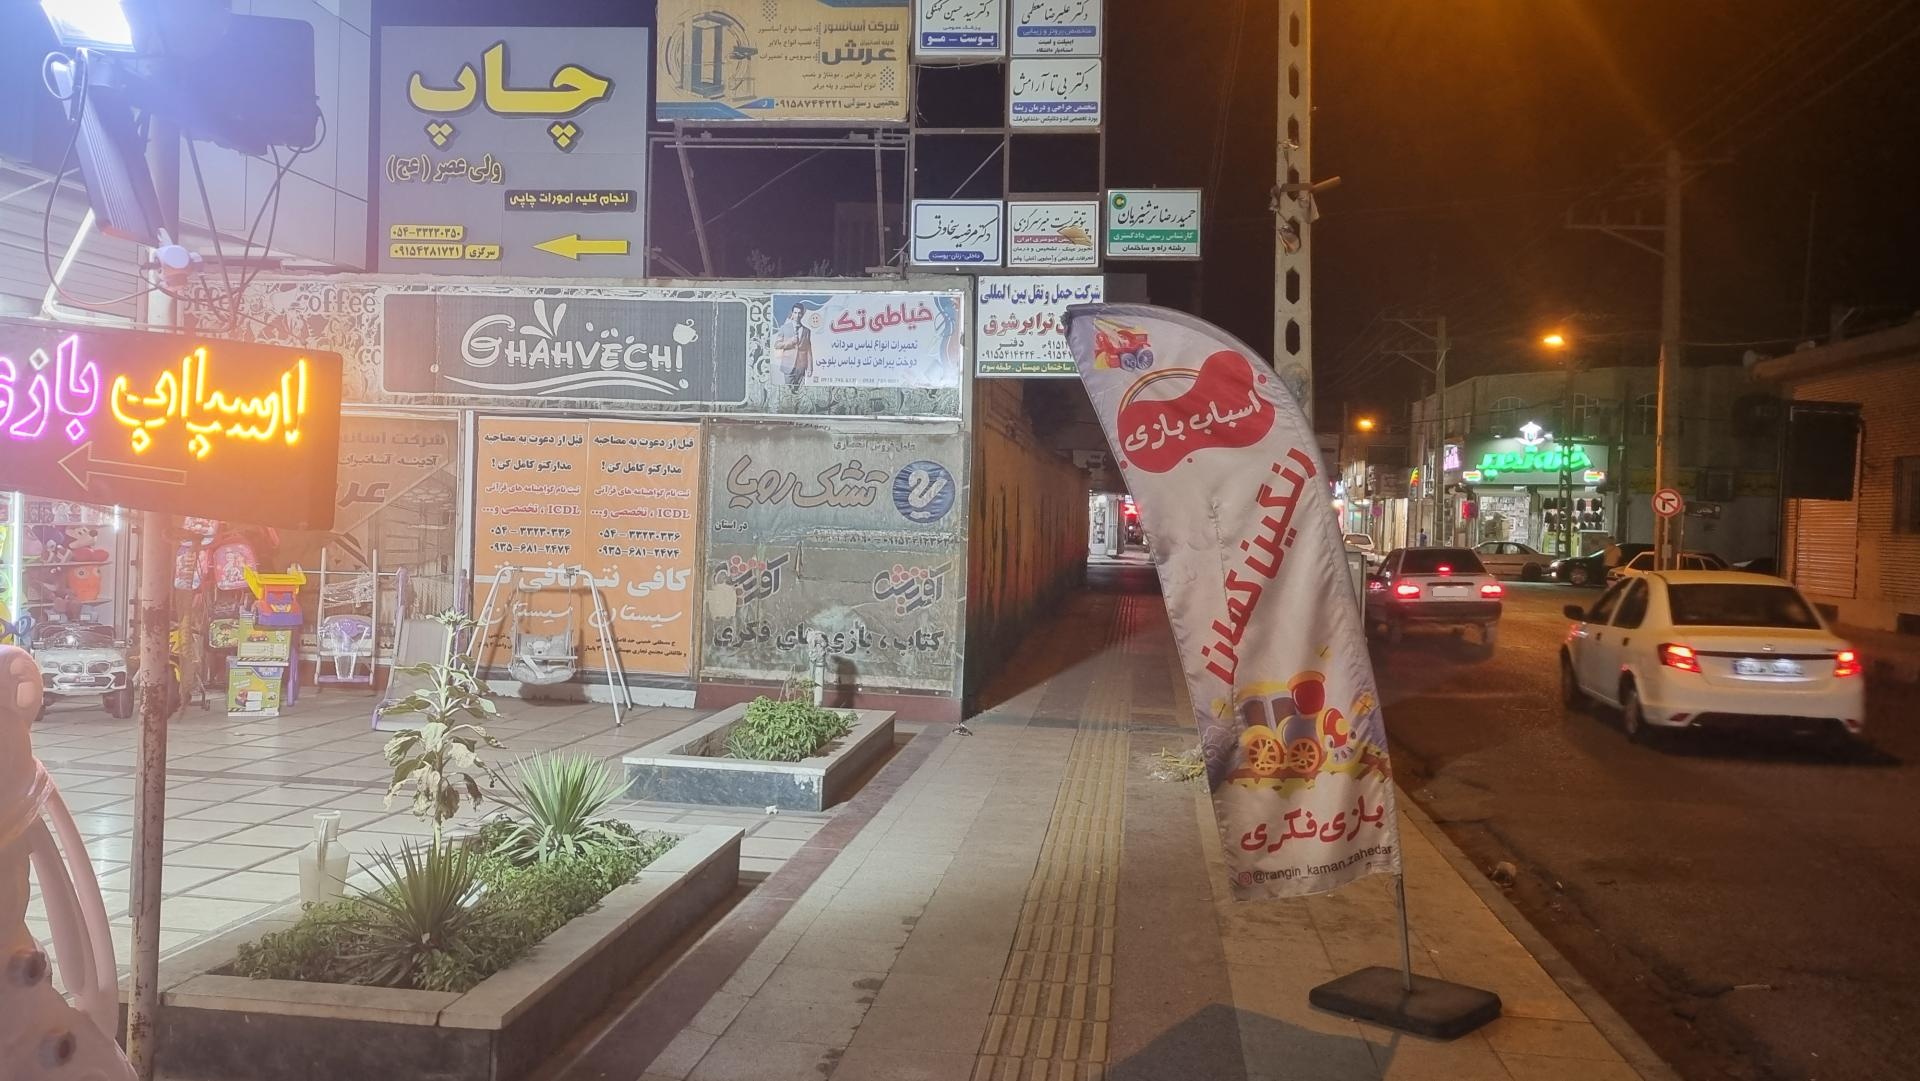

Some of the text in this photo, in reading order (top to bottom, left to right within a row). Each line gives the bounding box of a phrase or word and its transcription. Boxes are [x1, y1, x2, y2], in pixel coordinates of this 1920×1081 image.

[823, 20, 900, 34] شرکت آسانسور
[927, 34, 994, 46] پوست مو
[821, 39, 897, 66] عرش
[1069, 63, 1098, 94] دکتر
[409, 42, 611, 149] چاپ
[432, 158, 467, 182] عصر
[467, 153, 503, 183] ولی
[509, 192, 630, 208] انجام کلیه امورات چاپی
[970, 216, 999, 246] دکتر
[1113, 231, 1145, 241] دادگستری
[1165, 231, 1194, 241] کارشناس
[1121, 244, 1150, 252] ساختمان
[1168, 244, 1186, 252] رشته
[980, 284, 1101, 305] شرکت حمل و نقل بین المللی
[829, 301, 934, 335] خیاطی تک
[830, 338, 854, 351] مردانه
[854, 340, 874, 352] لباس
[997, 337, 1025, 351] دفتر
[815, 358, 837, 369] بلوچی
[837, 356, 857, 368] لباس
[895, 357, 918, 368] دوخت
[1040, 362, 1072, 373] ساختمان
[110, 345, 309, 461] اسباب
[1124, 388, 1262, 453] اسباب بازی
[484, 433, 583, 448] قبل از دعوت به مصاحبه
[594, 435, 694, 450] قبل از دعوت به مصاحبه
[513, 459, 535, 471] کامل
[622, 462, 645, 474] کامل
[508, 483, 522, 493] های
[791, 459, 891, 508] تشک
[617, 487, 632, 496] های
[548, 504, 580, 515] ICDL
[657, 508, 691, 519] ICDL
[622, 563, 691, 597] کافی
[1240, 795, 1385, 854] بازی فکری
